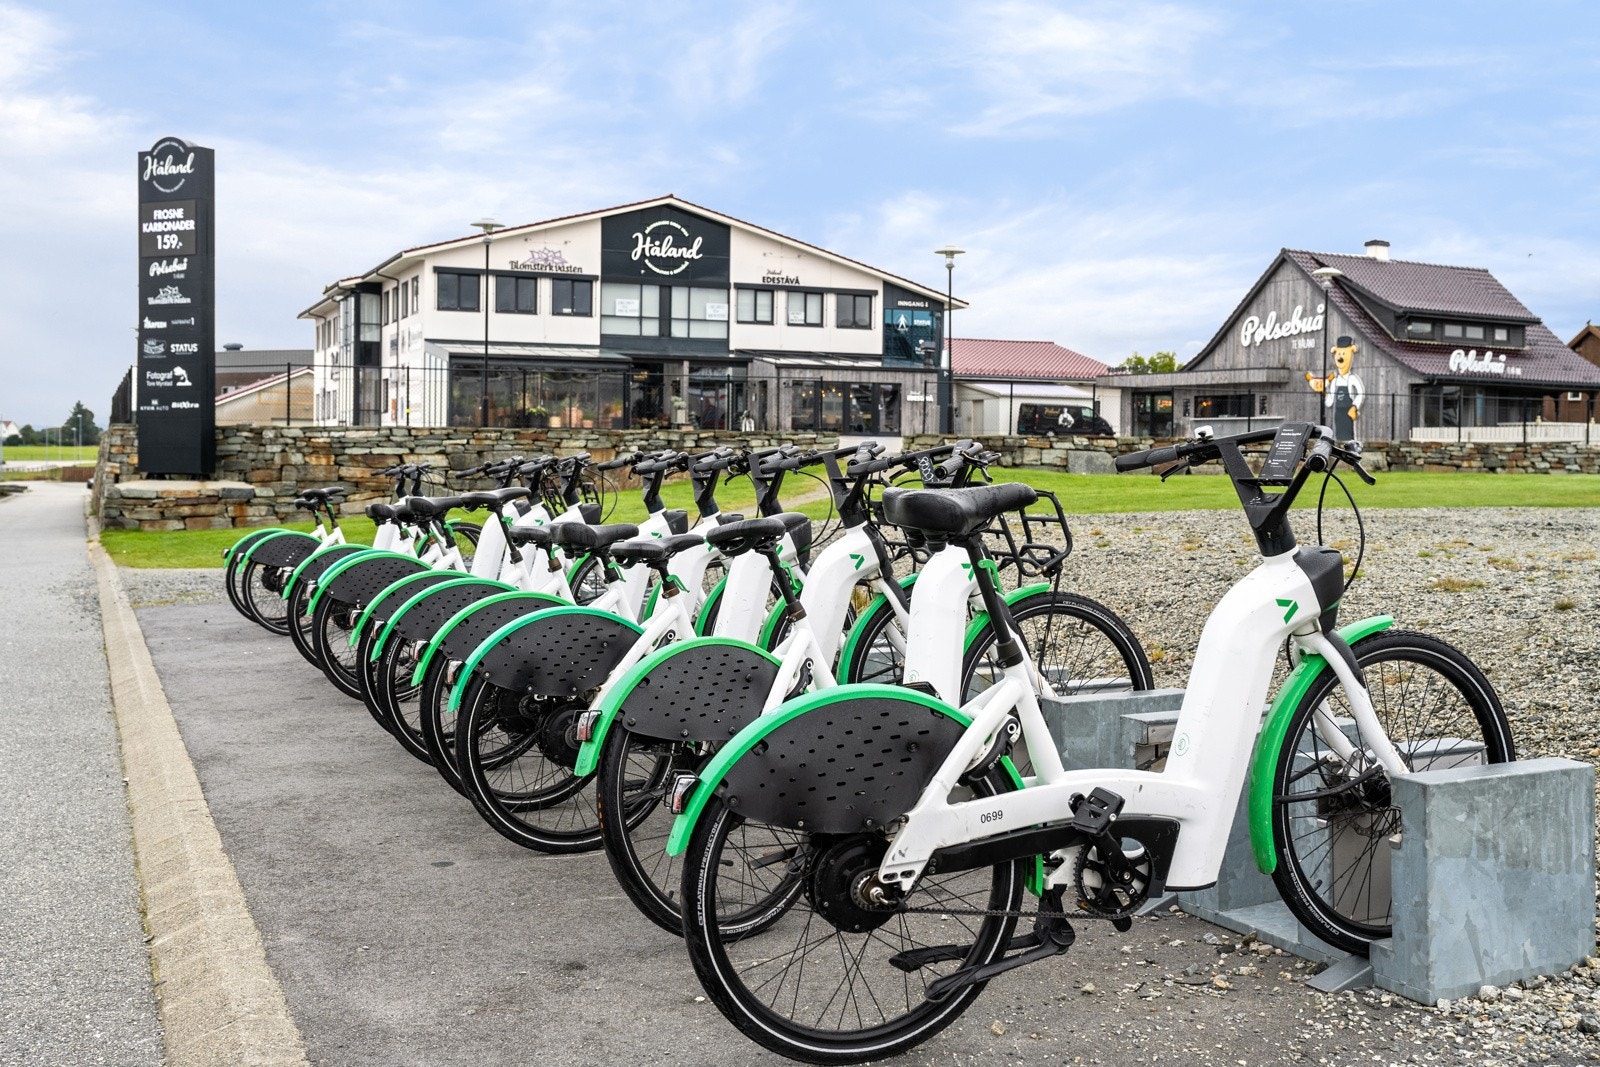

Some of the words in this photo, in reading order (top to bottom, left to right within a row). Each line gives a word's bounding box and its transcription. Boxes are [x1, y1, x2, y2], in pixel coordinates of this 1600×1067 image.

[143, 152, 195, 181] Håland
[153, 208, 184, 220] FROSNE
[142, 220, 195, 233] KARBONADER
[631, 232, 703, 261] Håland
[762, 276, 800, 284] EDESTÅVÅ
[897, 300, 924, 308] INNGANG
[1241, 303, 1325, 347] Pølsebuå
[170, 342, 199, 353] STATUS
[146, 371, 173, 381] Fotograf
[980, 810, 1003, 823] 0699
[697, 868, 705, 908] PLATINUM
[701, 822, 719, 868] PROTECTOR
[1290, 872, 1309, 906] PROTECTOR
[1308, 905, 1332, 929] PLATINUM
